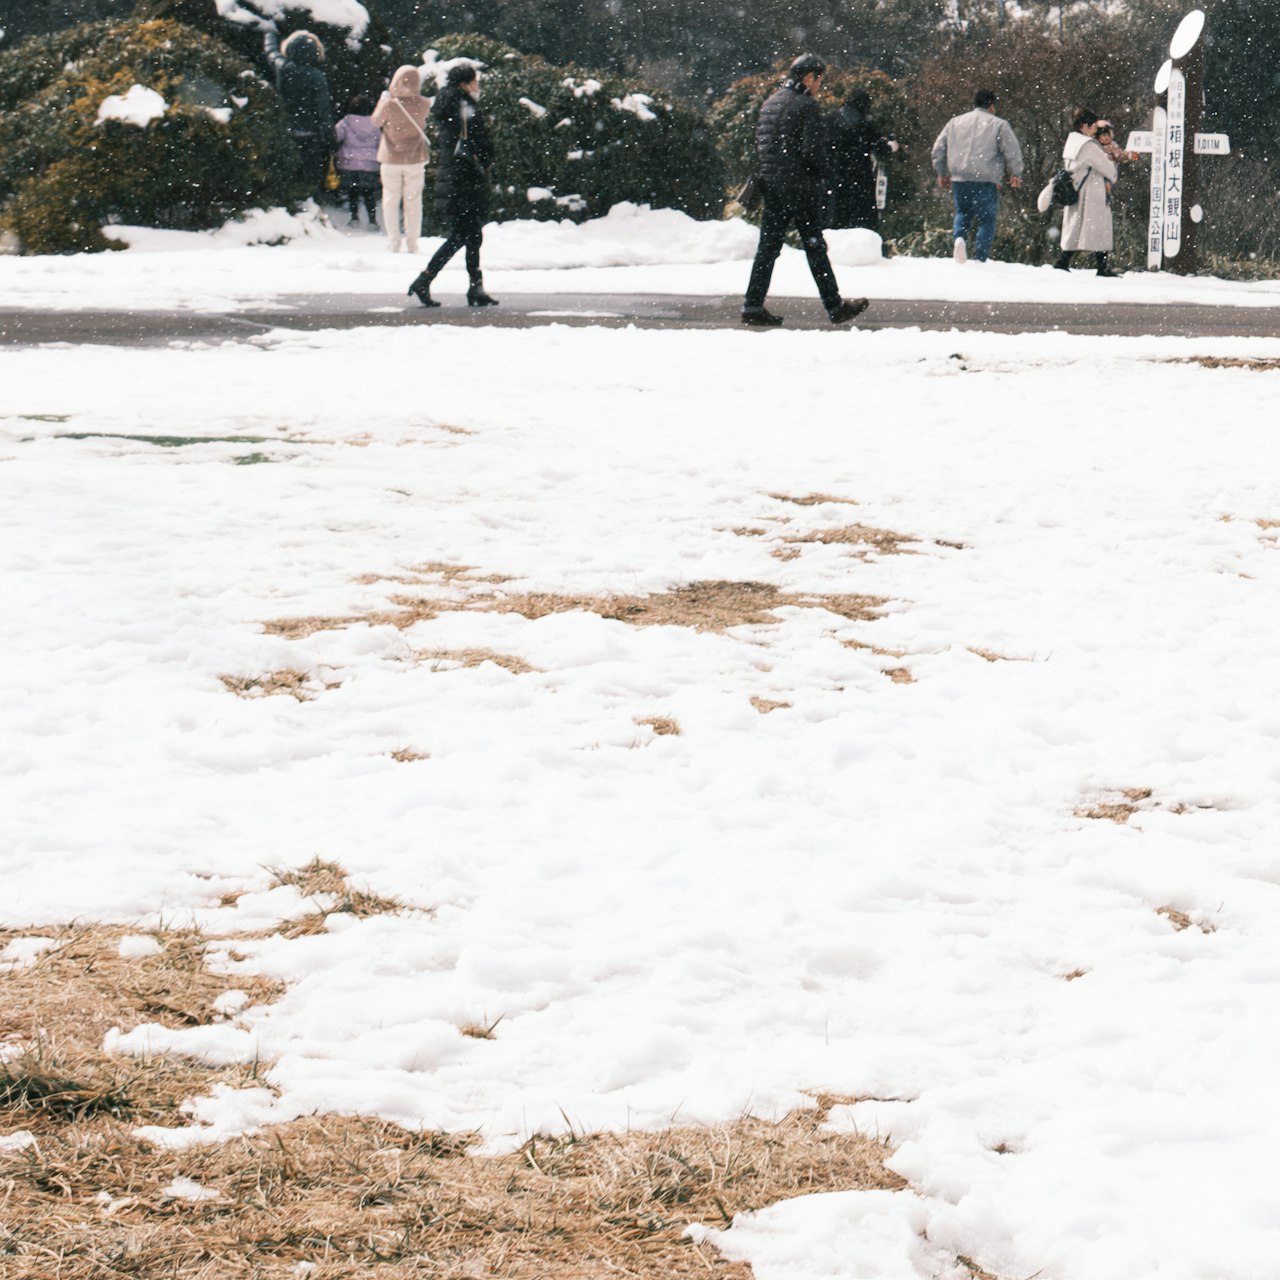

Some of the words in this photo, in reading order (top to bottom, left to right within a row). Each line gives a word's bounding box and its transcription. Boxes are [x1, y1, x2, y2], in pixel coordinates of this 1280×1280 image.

[1197, 138, 1221, 151] 1,011M
[1166, 125, 1182, 241] 箱根大観山
